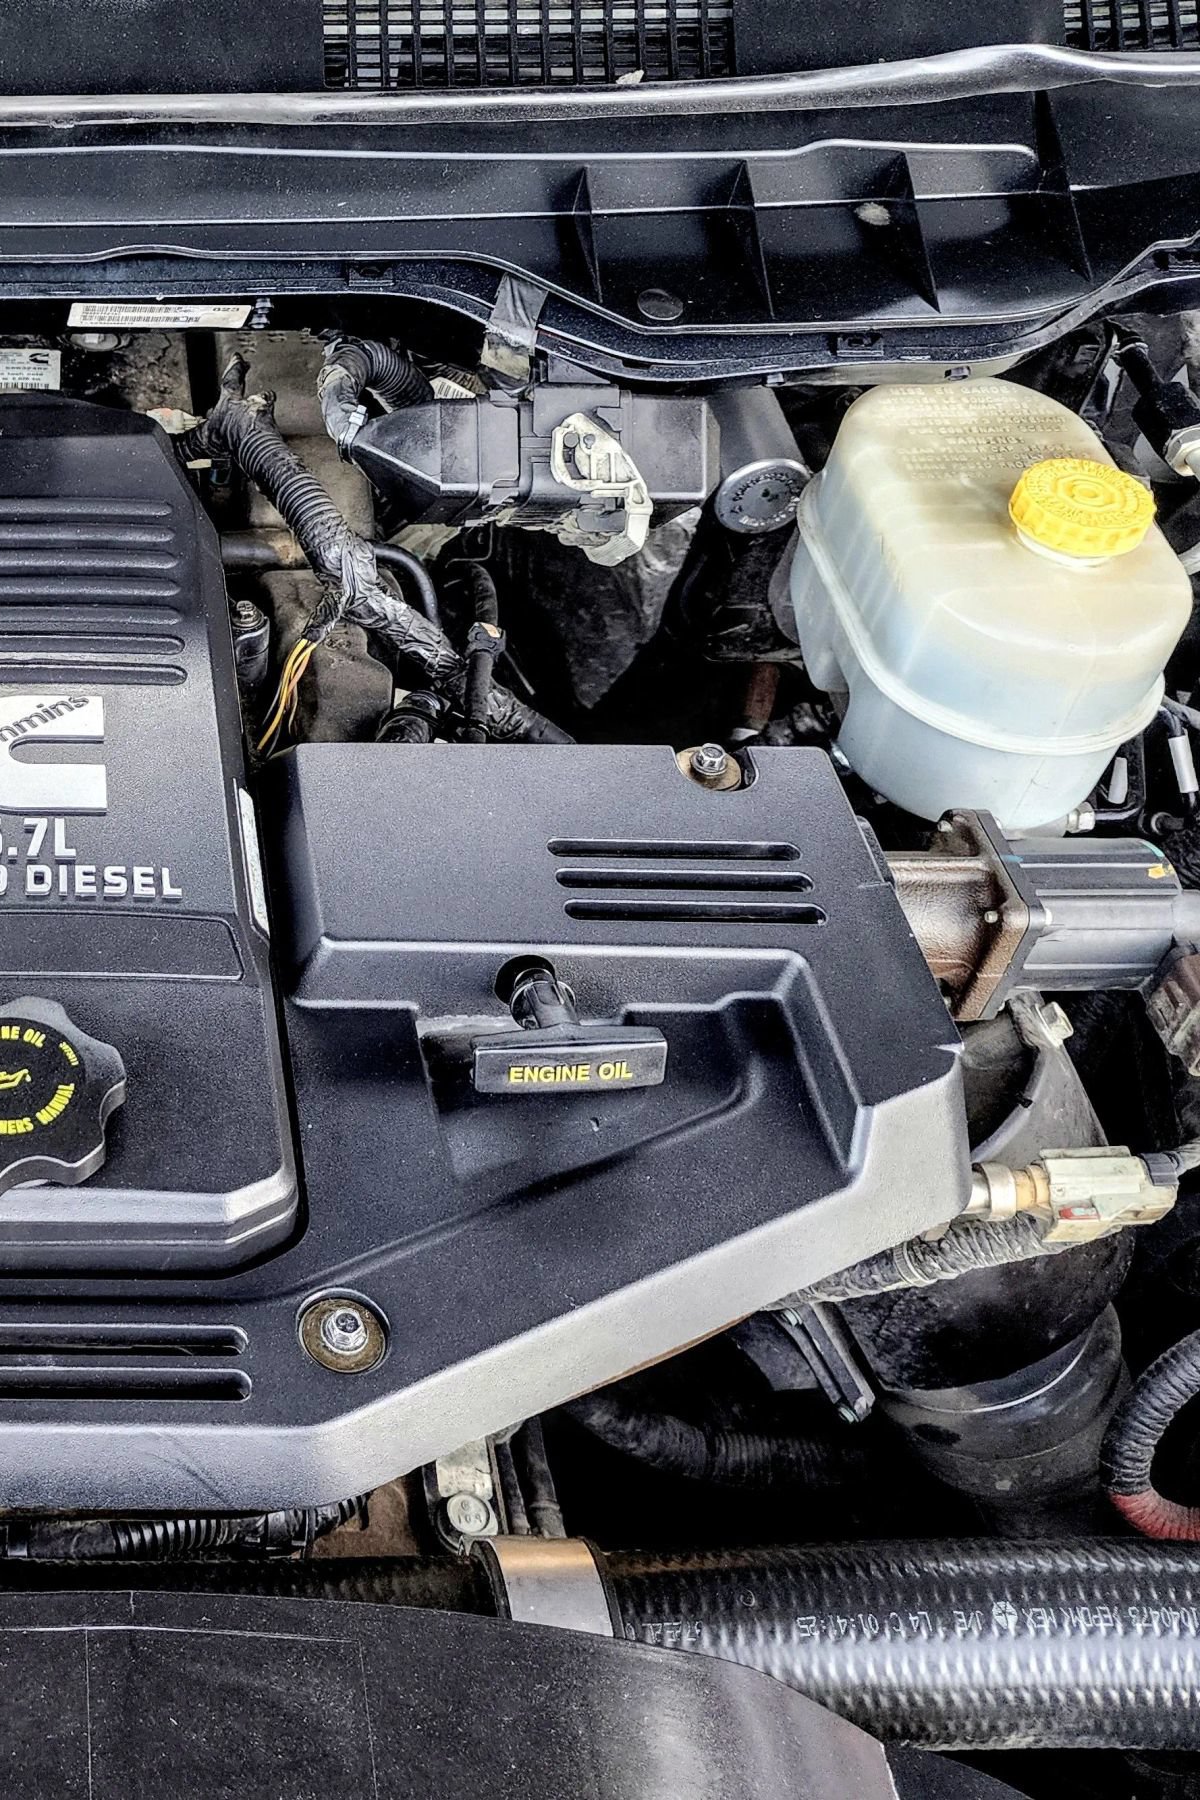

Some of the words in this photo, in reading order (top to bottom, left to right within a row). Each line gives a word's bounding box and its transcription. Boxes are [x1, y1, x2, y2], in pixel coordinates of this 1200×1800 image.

[25, 864, 183, 899] DIESEL
[23, 1028, 46, 1048] OIL
[509, 1064, 591, 1083] ENGINE
[598, 1061, 633, 1080] OIL
[35, 1083, 75, 1125] MANUAL
[796, 1615, 880, 1637] 01:41:25
[1021, 1607, 1058, 1629] MEX
